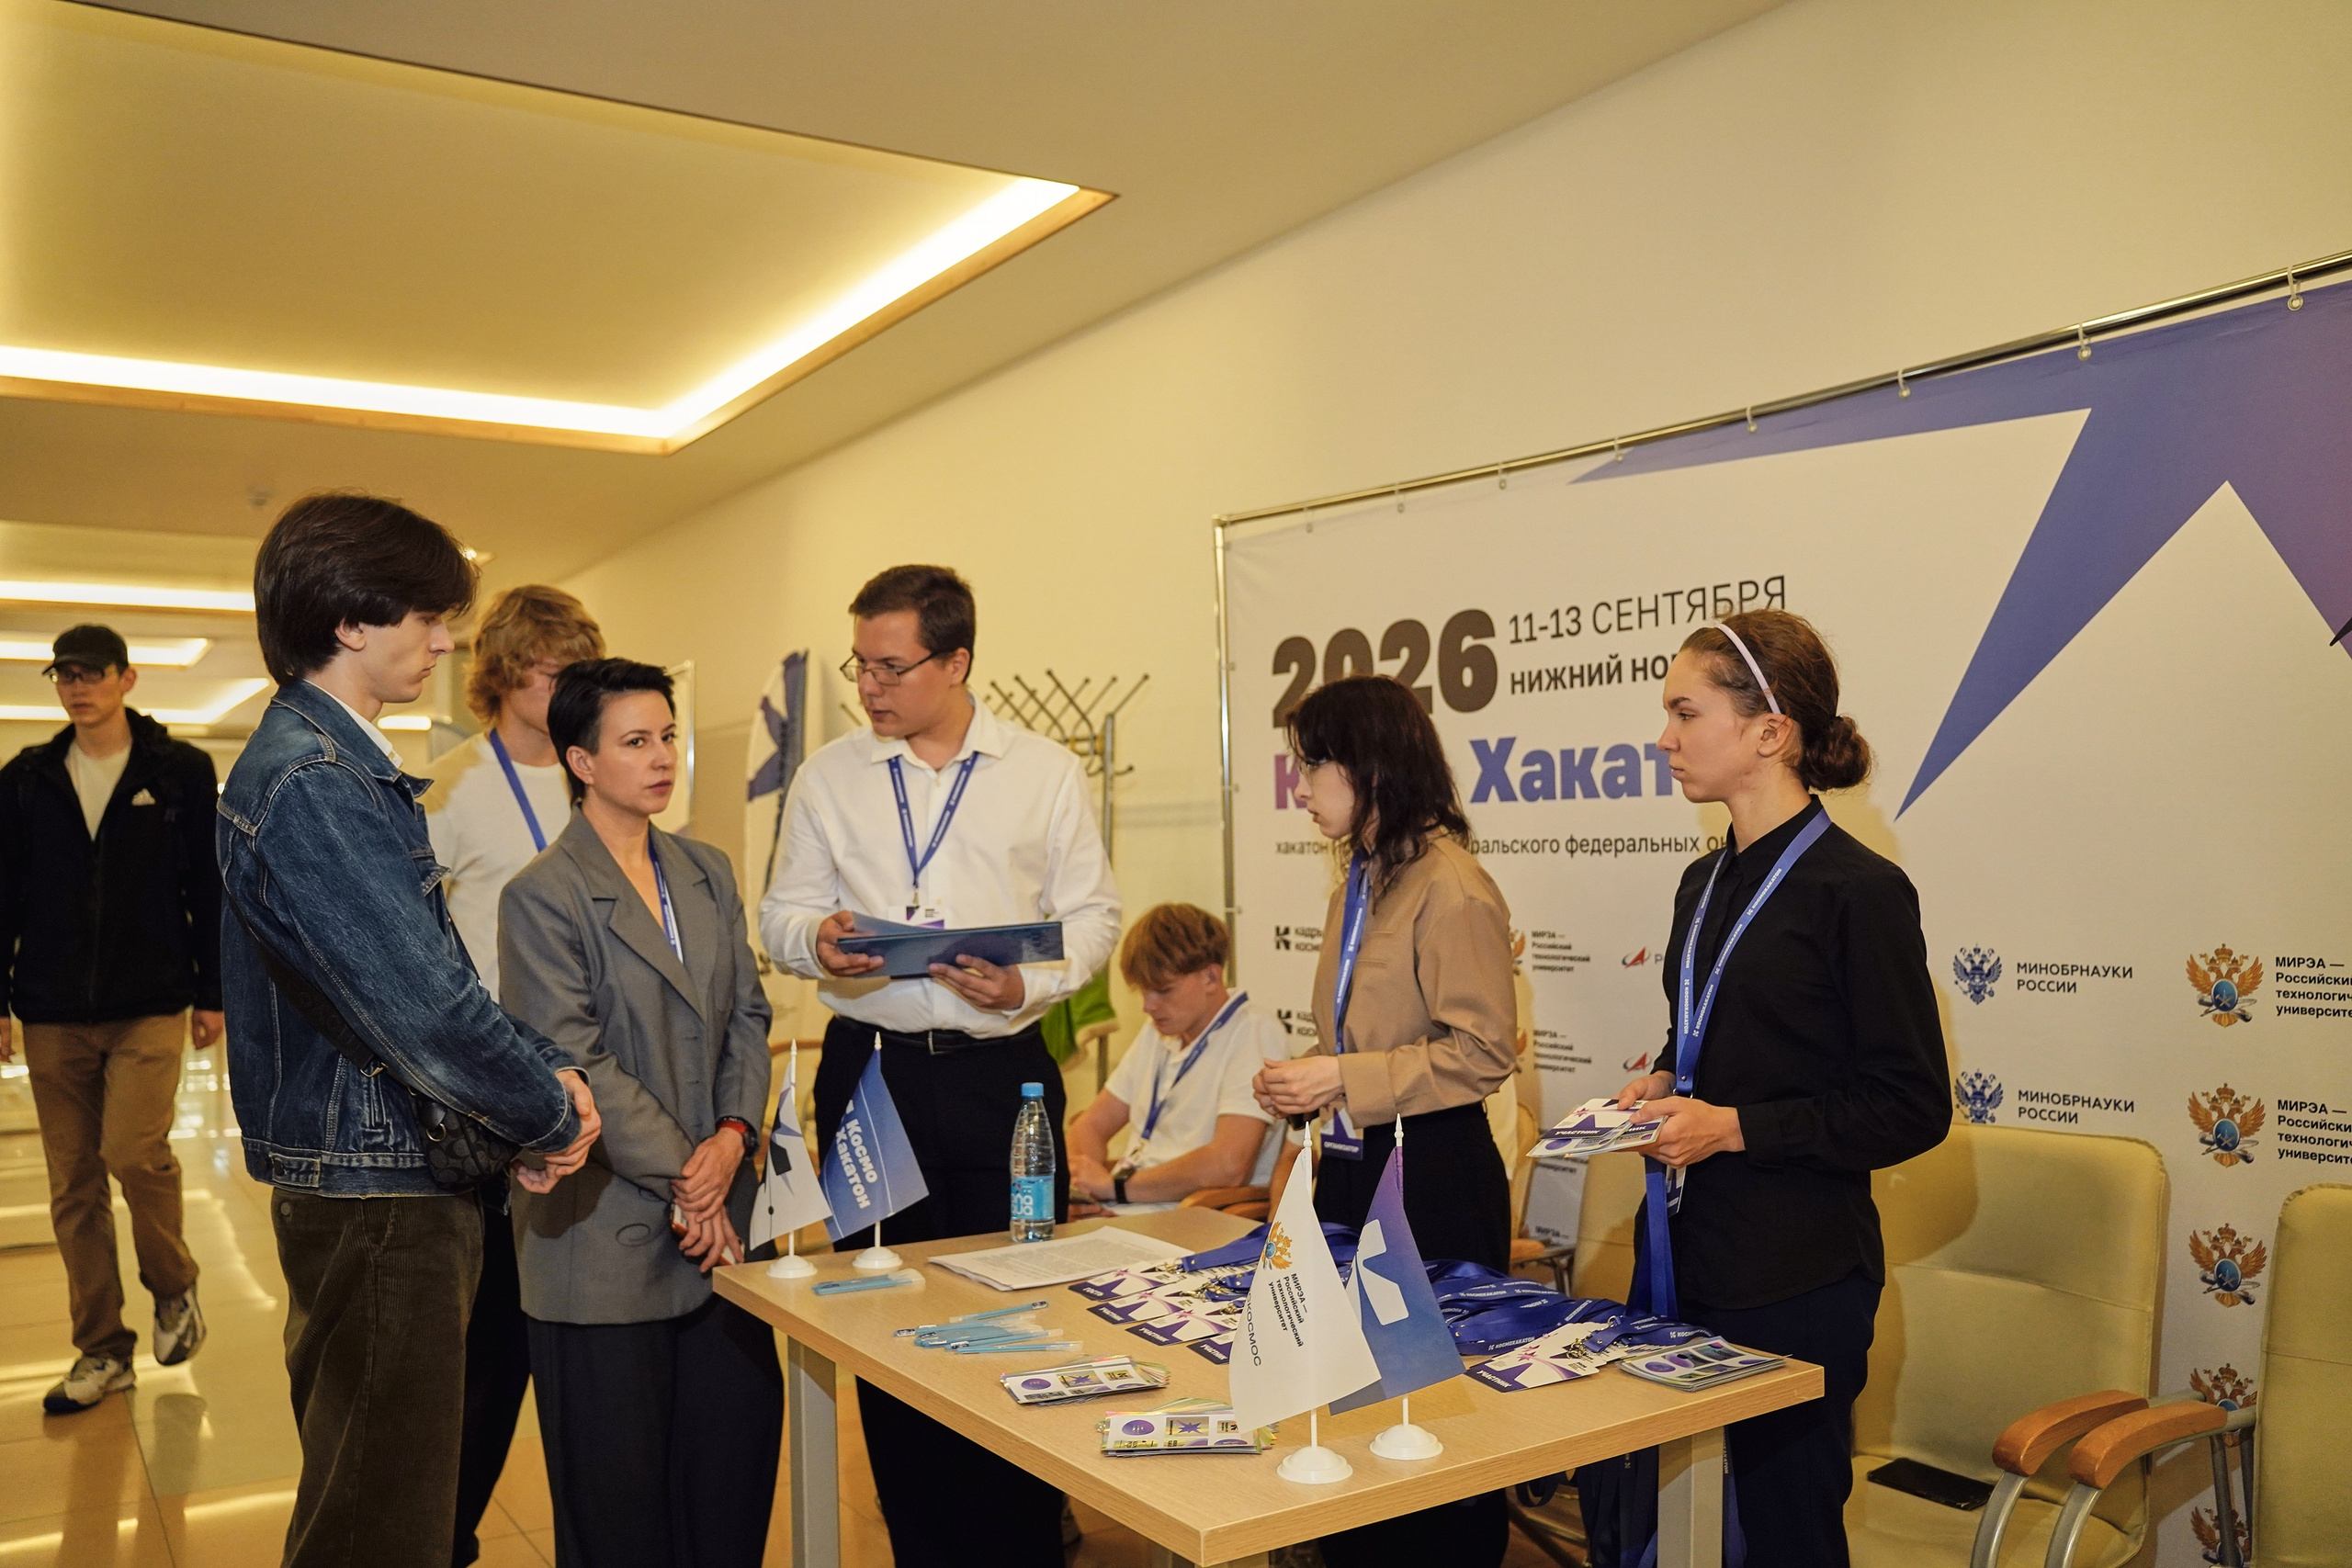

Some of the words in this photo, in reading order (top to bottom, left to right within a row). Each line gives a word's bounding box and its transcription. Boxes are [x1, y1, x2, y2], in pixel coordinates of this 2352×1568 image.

[1509, 605, 1582, 644] 11-13
[1592, 575, 1785, 634] СЕНТЯБРЯ
[1272, 608, 1498, 728] 2026
[1510, 653, 1623, 694] НИЖНИЙ
[1468, 736, 1673, 804] Хакат
[1470, 838, 1560, 855] ральского
[1565, 834, 1700, 858] федеральных
[2017, 963, 2133, 979] МИНОБРНАУКИ
[2275, 956, 2326, 969] МИРЭА
[2017, 979, 2077, 993] РОССИИ
[2275, 989, 2352, 1001] технологич
[2276, 1005, 2352, 1019] университе
[2018, 1089, 2134, 1113] МИНОБРНАУКИ
[2278, 1099, 2328, 1114] МИРЭА
[2018, 1107, 2078, 1124] РОССИИ
[2278, 1115, 2352, 1133] Российски
[845, 1118, 877, 1183] Космо
[2278, 1133, 2352, 1148] технологи
[836, 1126, 871, 1209] Хакатон
[2278, 1148, 2352, 1164] университ
[1291, 1272, 1306, 1303] МИРЭА
[1269, 1281, 1288, 1331] университет
[1283, 1276, 1305, 1324] Российский
[1276, 1279, 1304, 1347] технологический
